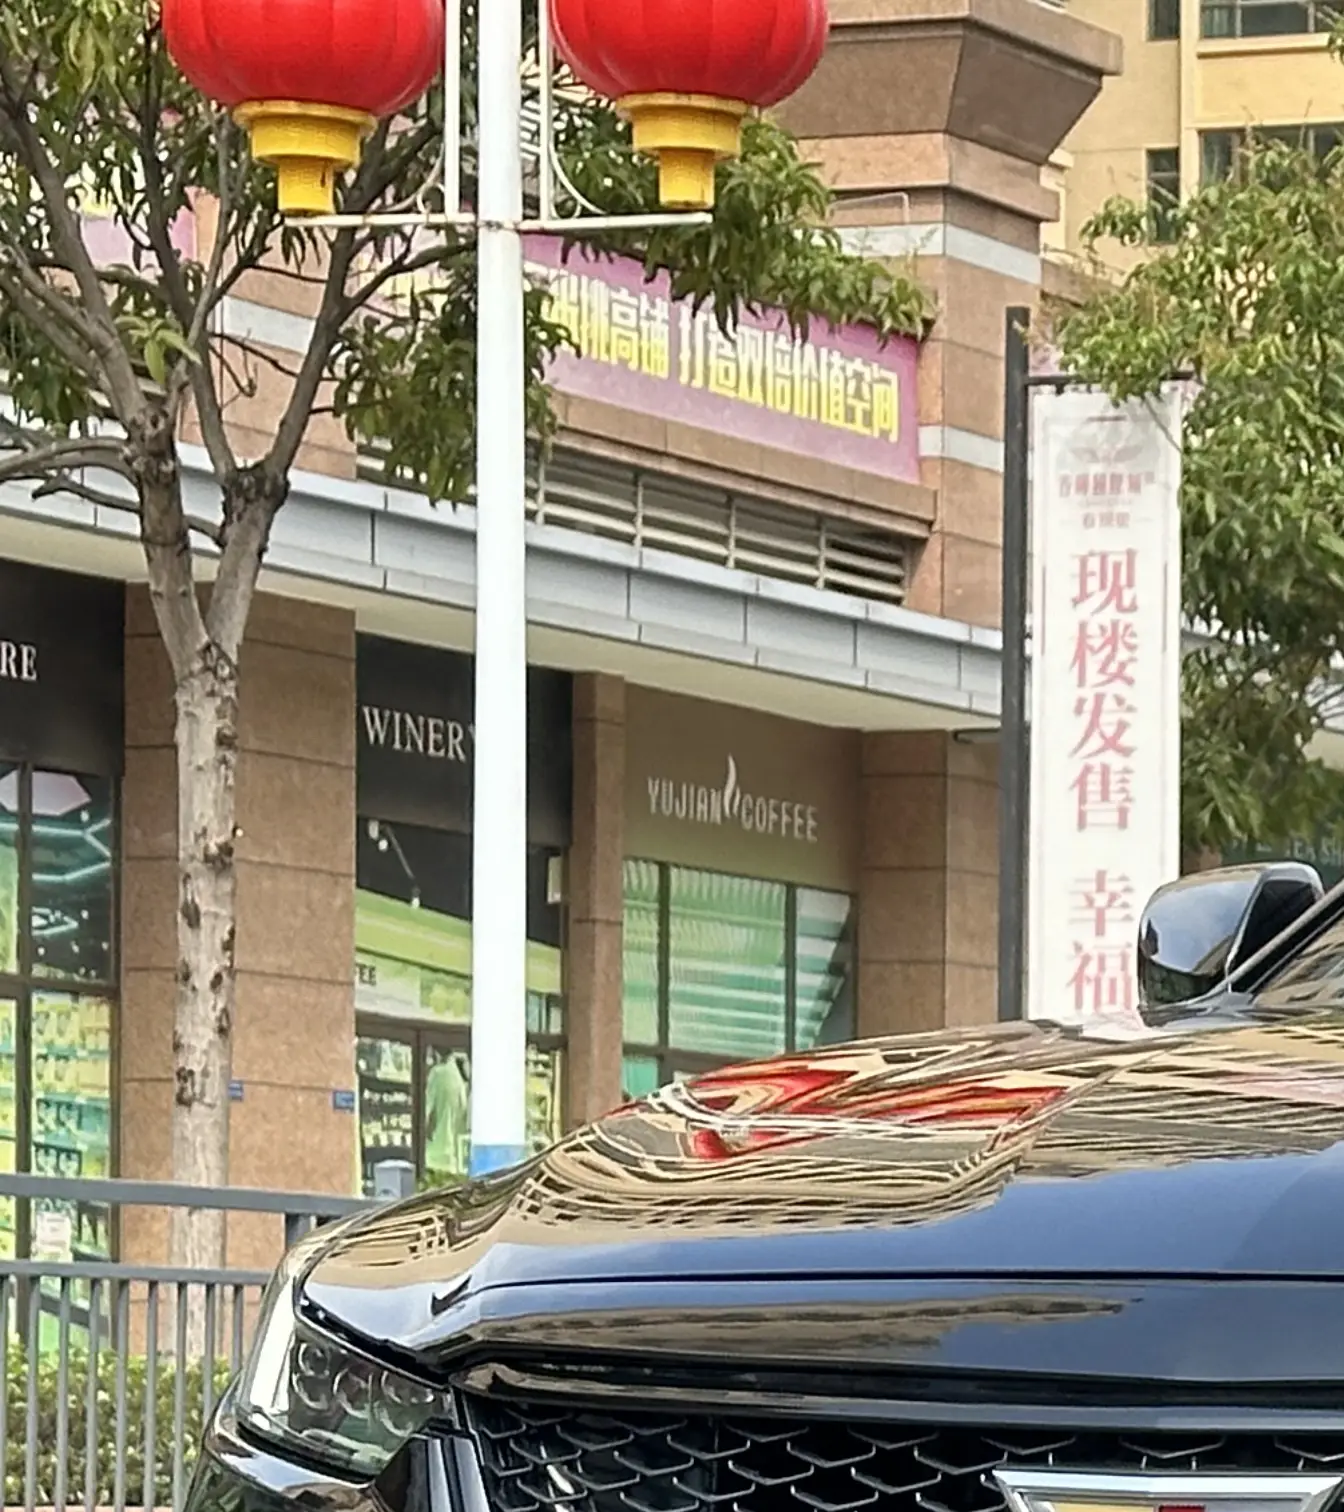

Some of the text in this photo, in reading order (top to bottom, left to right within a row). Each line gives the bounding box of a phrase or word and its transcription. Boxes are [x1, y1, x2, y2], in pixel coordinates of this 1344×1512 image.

[0, 640, 37, 681] RE
[1069, 548, 1138, 832] 现楼发售
[648, 776, 818, 844] YUJIAN COFFEE
[1066, 869, 1136, 1013] 幸福
